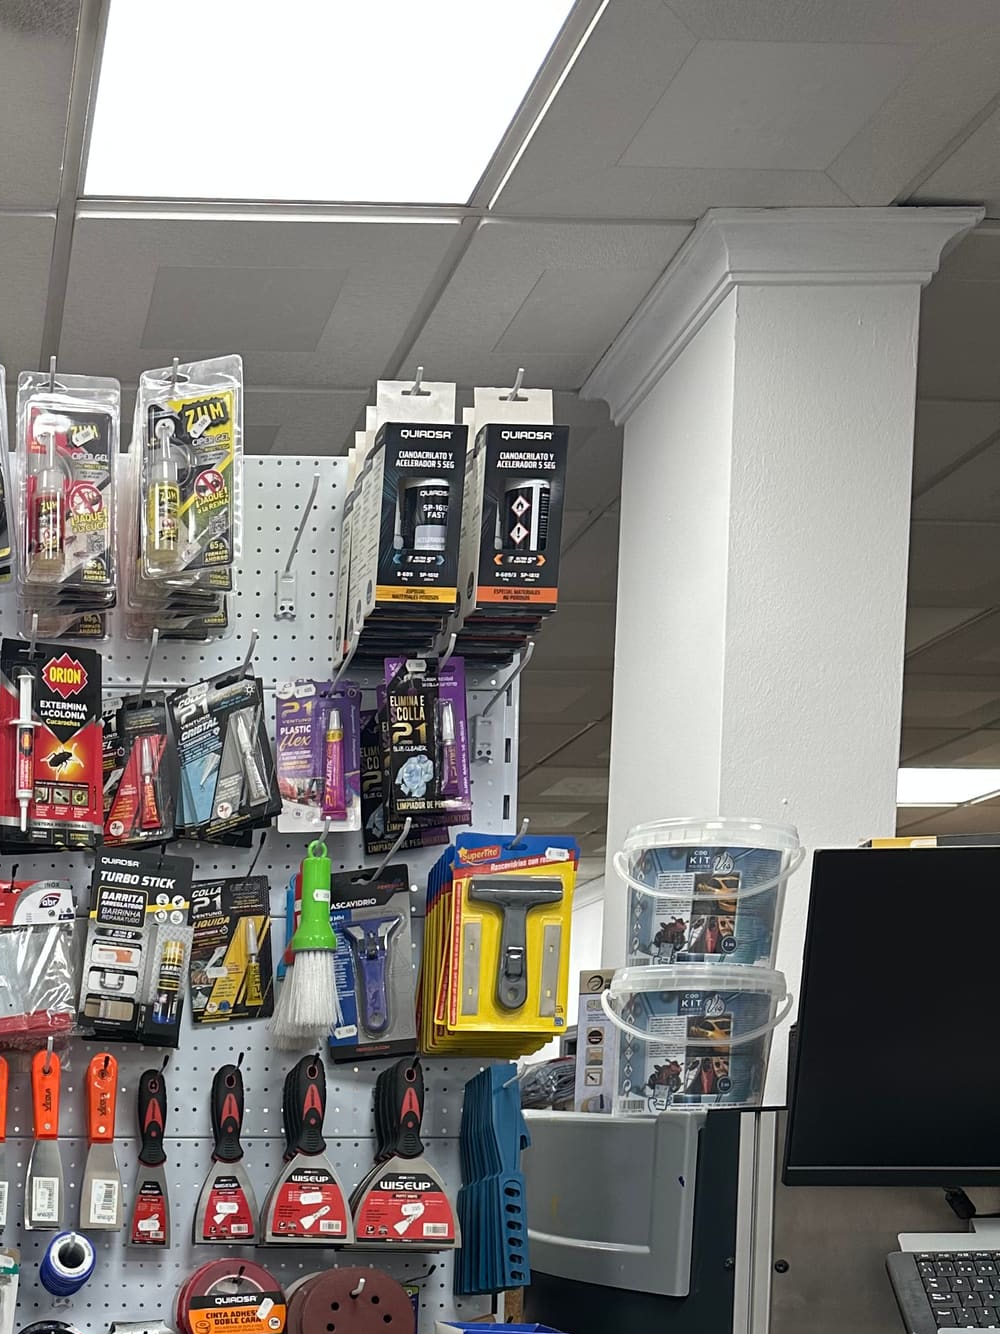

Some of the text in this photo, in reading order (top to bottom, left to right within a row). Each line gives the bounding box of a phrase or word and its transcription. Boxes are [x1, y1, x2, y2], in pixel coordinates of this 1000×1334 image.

[399, 451, 453, 460] CIANOACRILATO Y
[500, 452, 554, 461] CIANOACRILATO Y
[395, 459, 455, 469] ACELERADOR 5 SEG
[497, 461, 556, 470] ACELERADOR 5 SEG
[427, 511, 445, 519] FAST
[49, 667, 81, 684] ORION
[40, 700, 88, 712] EXTERMINA
[281, 700, 313, 717] 21
[49, 710, 85, 721] COLONIA
[182, 717, 219, 741] CRISTAL
[280, 724, 311, 735] PLASTIC
[392, 722, 427, 744] 21
[280, 734, 311, 750] flex
[490, 861, 527, 871] Rascavidrios
[100, 871, 176, 889] TURBO STICK
[101, 891, 144, 904] BARRITA
[192, 887, 222, 898] COLLA
[193, 896, 222, 914] 21
[330, 898, 376, 910] ASCAVIDRIO
[101, 909, 141, 918] BARRINHA
[192, 916, 230, 930] LIQUIDA
[681, 1000, 702, 1008] KIT
[291, 1175, 329, 1183] WISEUP
[380, 1181, 431, 1190] WISEUP
[206, 1310, 258, 1319] CINTA ADHES
